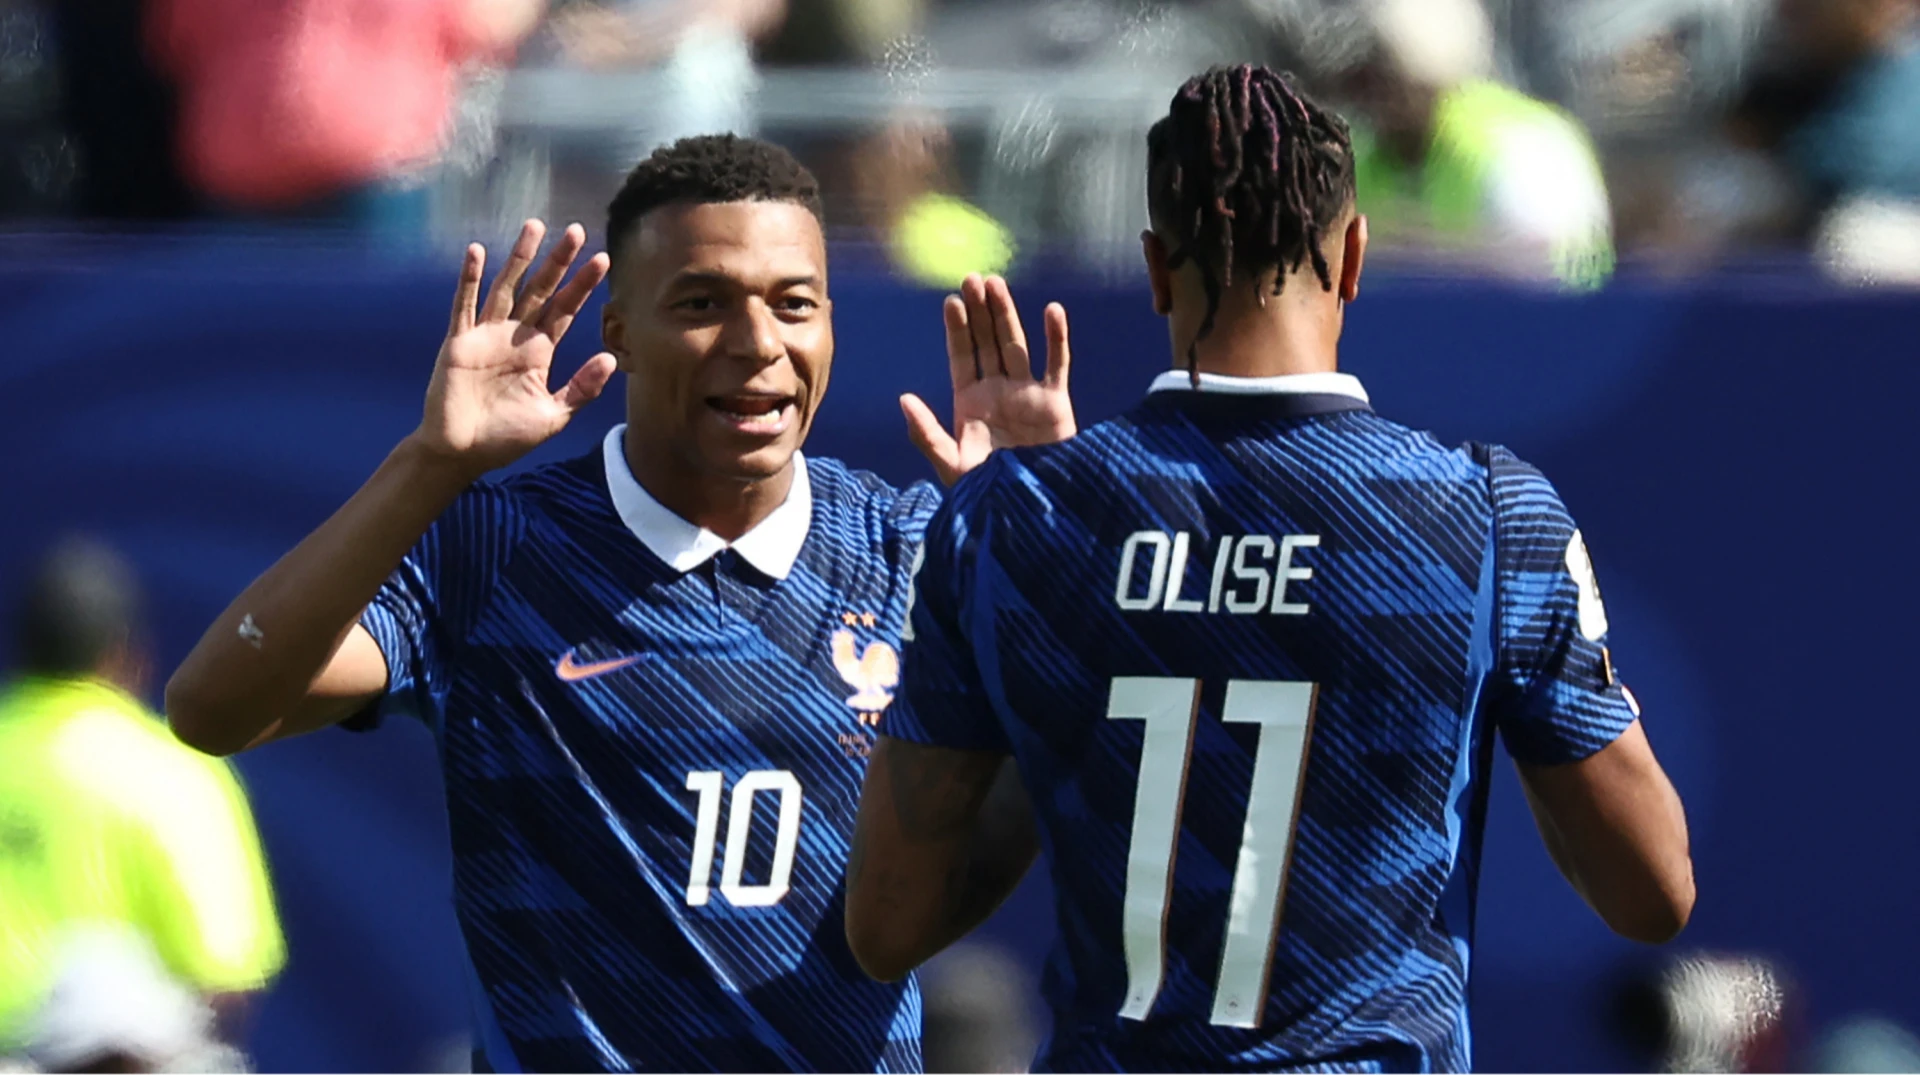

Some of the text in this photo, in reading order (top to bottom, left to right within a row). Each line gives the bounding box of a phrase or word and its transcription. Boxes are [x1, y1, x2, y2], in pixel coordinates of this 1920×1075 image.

[1116, 530, 1320, 615] OLISE
[686, 770, 802, 907] 10
[1107, 677, 1318, 1028] 11
